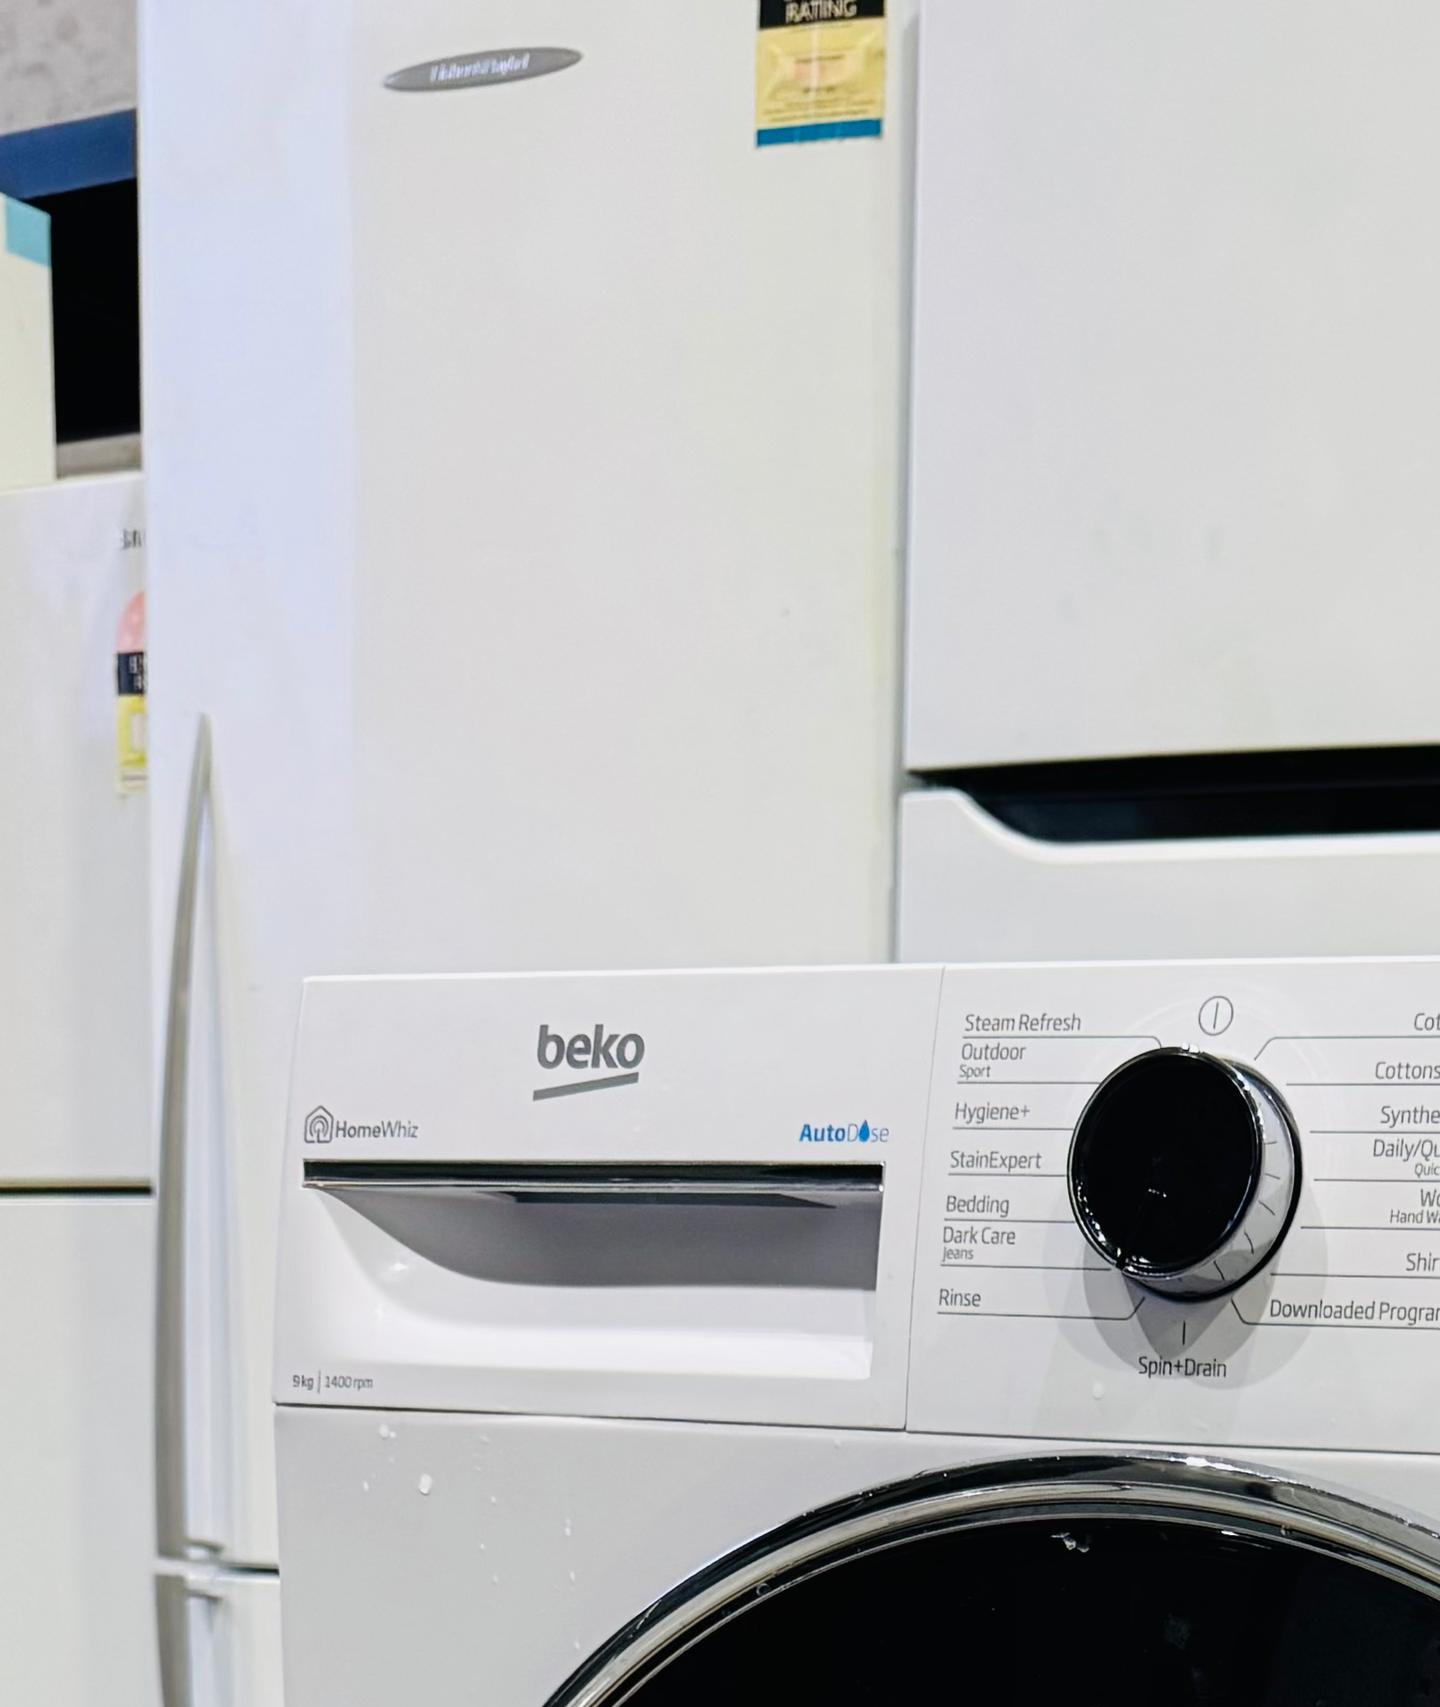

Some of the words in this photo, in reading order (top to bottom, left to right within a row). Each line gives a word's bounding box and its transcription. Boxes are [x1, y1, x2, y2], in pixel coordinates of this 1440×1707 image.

[785, 0, 858, 24] RATING
[964, 1013, 1015, 1032] Steam
[1018, 1013, 1082, 1032] Refresh
[537, 1024, 645, 1070] beko
[961, 1043, 1027, 1061] Outdoor
[959, 1064, 991, 1080] Sport
[954, 1101, 1031, 1125] Hygiene+
[335, 1119, 419, 1139] HomeWhiz
[950, 1150, 1042, 1173] StainExpert
[945, 1195, 1010, 1218] Bedding
[1389, 1209, 1424, 1225] Hand
[942, 1226, 978, 1245] Dark
[981, 1227, 1016, 1246] Care
[941, 1246, 974, 1263] Jeans
[938, 1288, 982, 1308] Rinse
[1269, 1299, 1375, 1321] Downloaded
[1137, 1356, 1228, 1379] Spin+Drain
